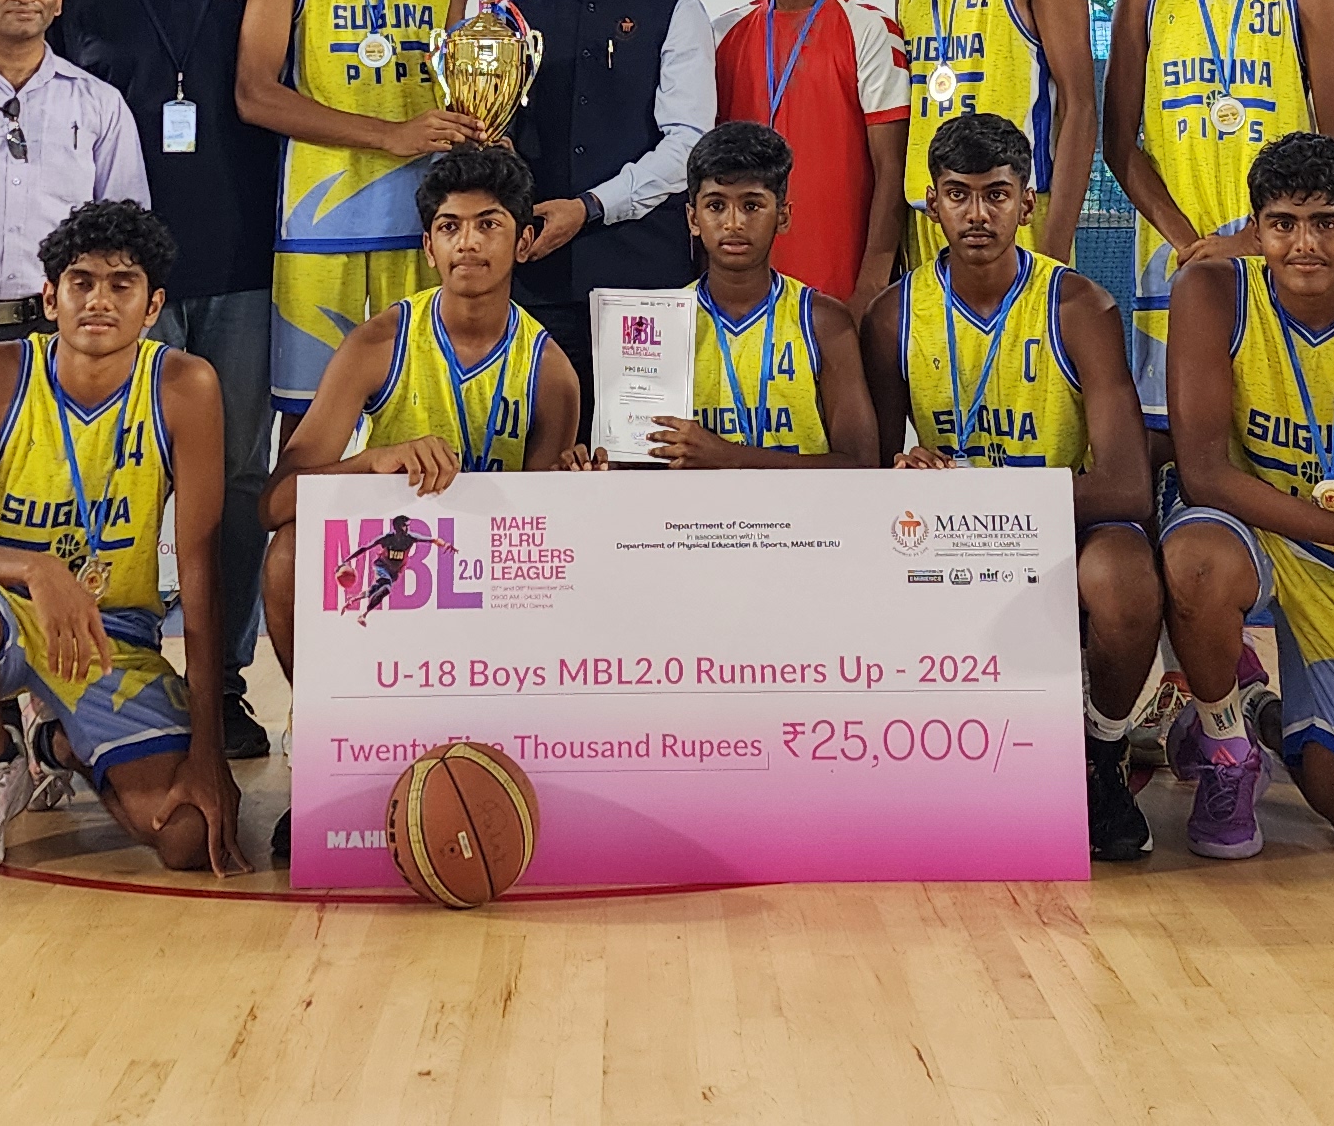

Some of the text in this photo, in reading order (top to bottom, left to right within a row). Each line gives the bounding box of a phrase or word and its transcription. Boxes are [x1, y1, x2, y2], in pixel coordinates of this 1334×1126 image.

[1248, 0, 1282, 37] 30
[490, 515, 547, 531] MAHE
[665, 521, 791, 532] Department of Commerce
[934, 514, 1038, 532] MANIPAL
[490, 532, 544, 548] B'LRU
[616, 542, 666, 551] Department
[667, 541, 676, 550] of
[677, 541, 710, 551] Physical
[711, 541, 751, 550] Education
[323, 517, 484, 611] MBL 2.0
[490, 548, 575, 564] BALLERS
[490, 565, 567, 581] LEAGUE
[376, 660, 457, 689] U-18
[469, 659, 547, 692] Boys
[559, 657, 684, 687] MBL2.0
[696, 656, 828, 685] Runners
[839, 655, 884, 689] Up
[918, 655, 1001, 683] 2024
[514, 733, 651, 761] Thousand
[661, 733, 763, 763] Rupees
